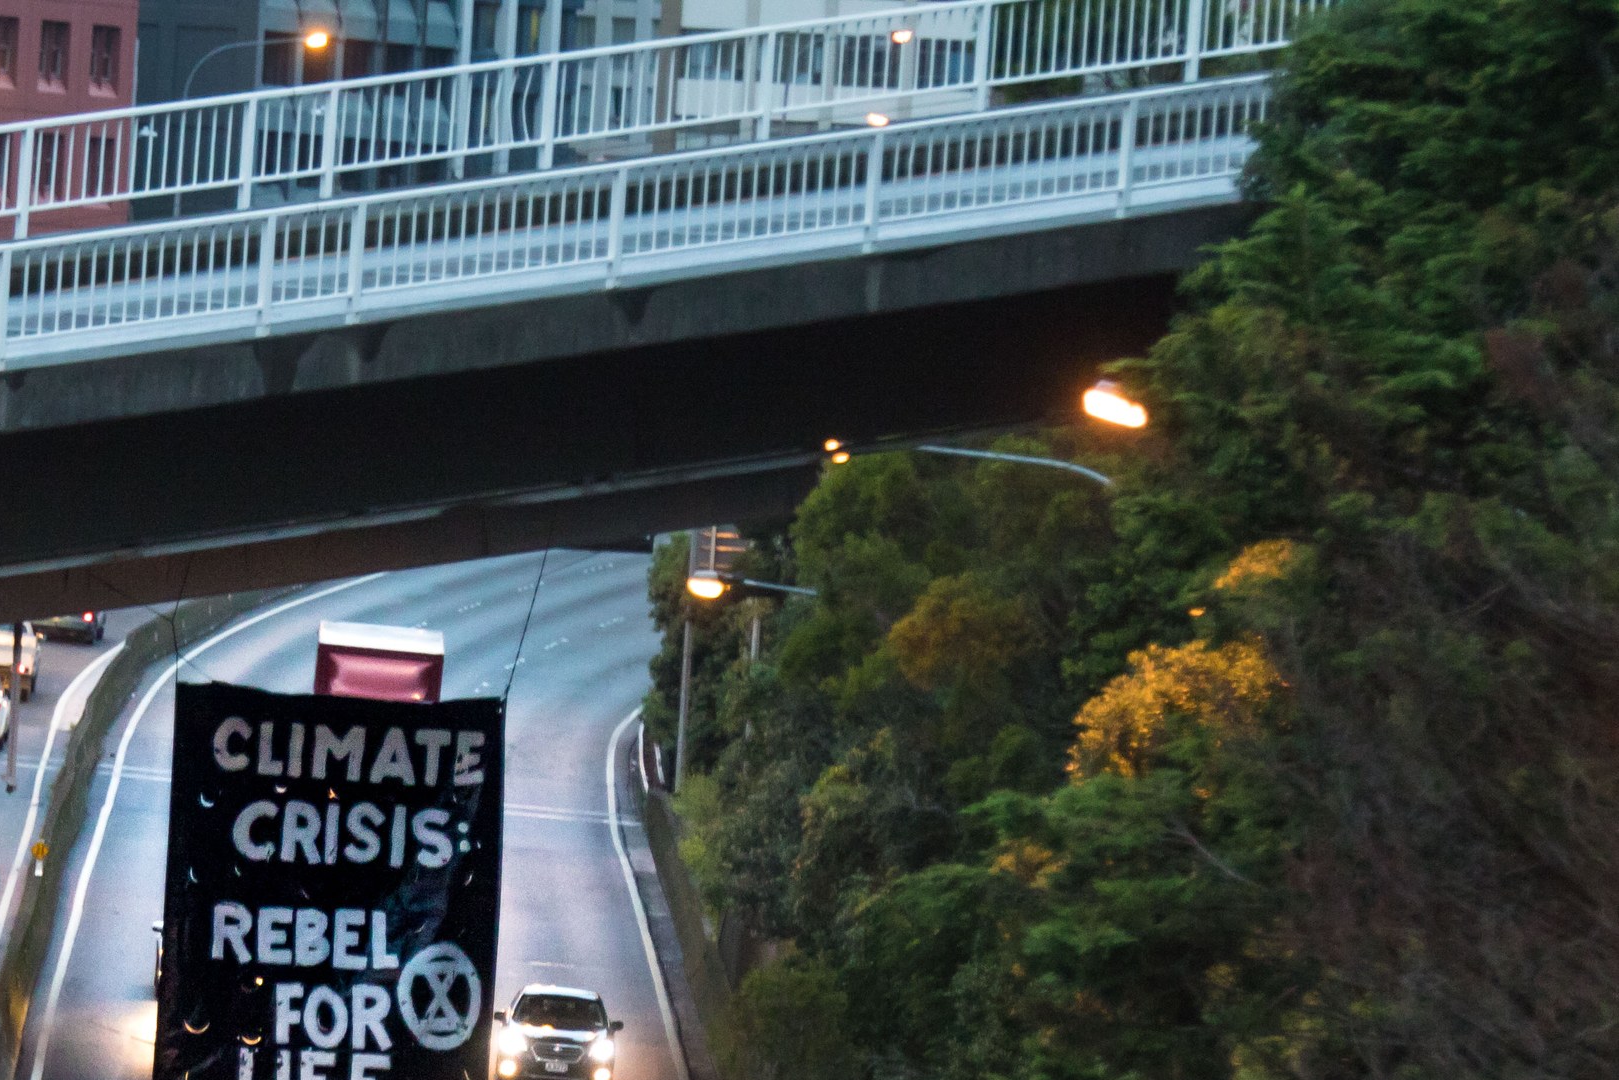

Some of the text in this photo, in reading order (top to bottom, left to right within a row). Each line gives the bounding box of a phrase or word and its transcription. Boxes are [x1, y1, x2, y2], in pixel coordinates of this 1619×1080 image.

[212, 716, 487, 788] CLIMATE
[232, 801, 471, 869] CRISIS:
[211, 902, 400, 971] REBEL
[273, 982, 393, 1052] FOR
